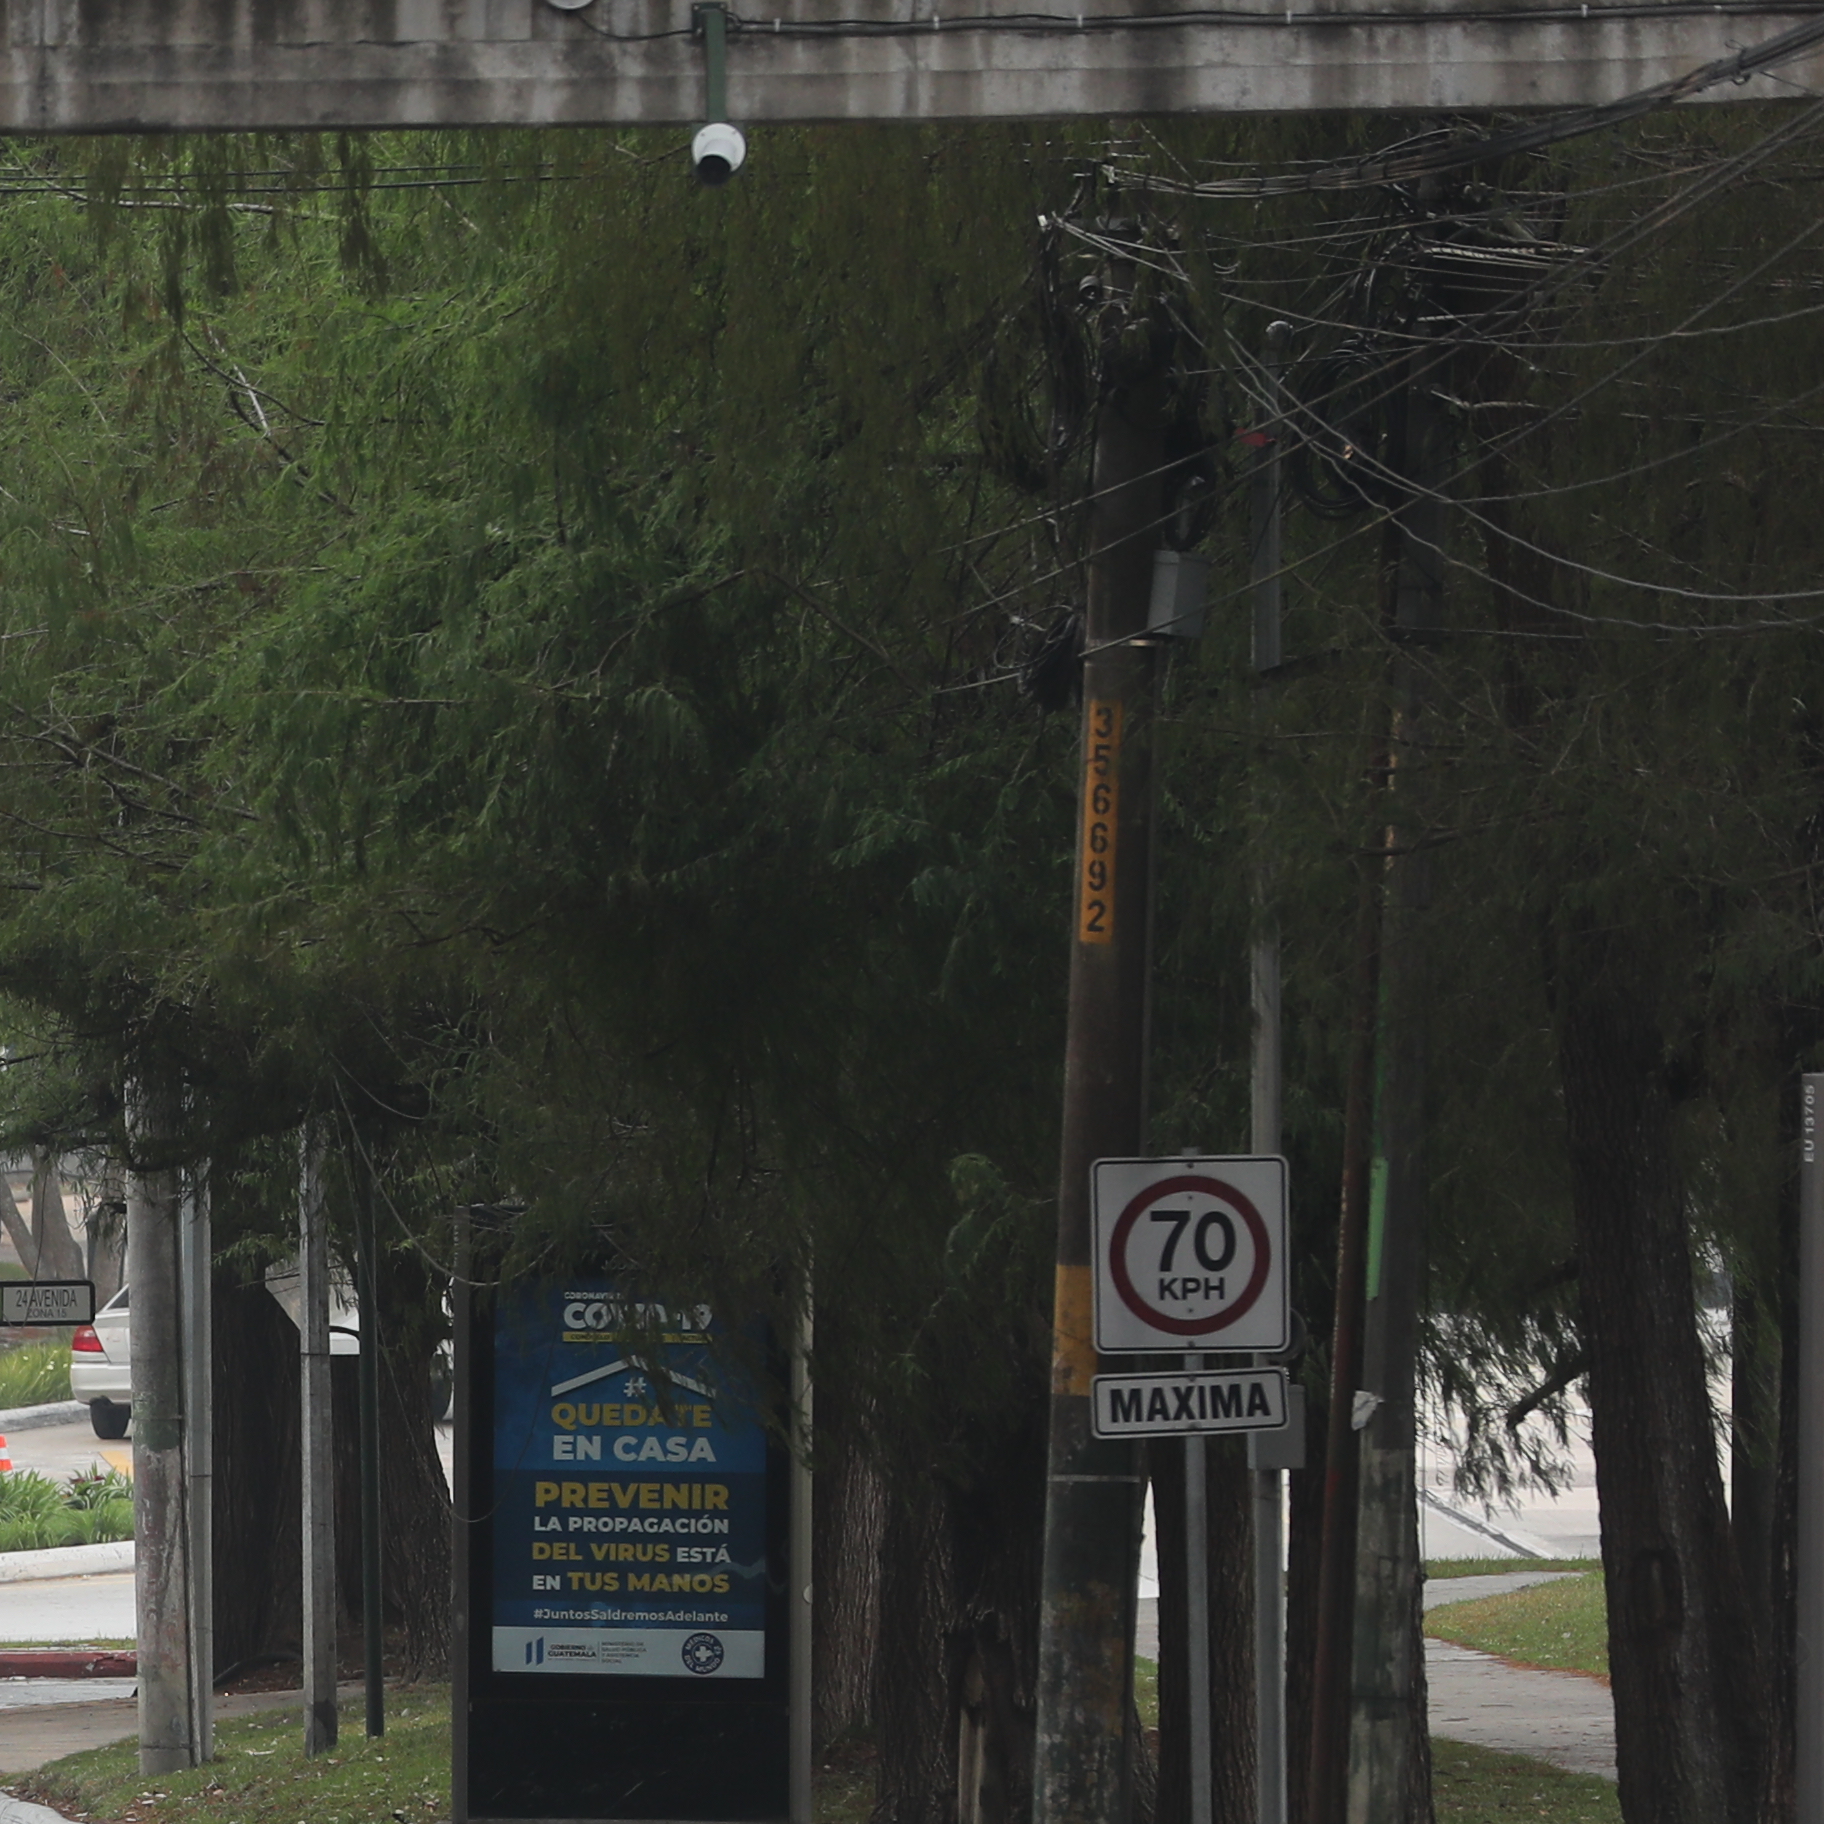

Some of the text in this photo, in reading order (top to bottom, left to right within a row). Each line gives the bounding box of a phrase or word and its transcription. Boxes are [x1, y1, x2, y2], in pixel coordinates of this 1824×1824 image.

[1087, 707, 1114, 933] 356692
[1804, 1139, 1814, 1163] EU
[1150, 1211, 1236, 1272] 70
[16, 1289, 77, 1307] 24 AVENIDA
[1159, 1277, 1225, 1300] KPH
[27, 1308, 67, 1318] ZONA 15
[1109, 1383, 1272, 1423] MAXIMA
[553, 1435, 716, 1463] EN CASA
[535, 1481, 729, 1510] PREVENIR
[534, 1514, 729, 1534] LA PROPAGACIÓN
[532, 1542, 731, 1564] DEL VIRUS ESTÁ
[532, 1571, 730, 1593] EN TUS MANOS
[533, 1609, 729, 1623] #JuntosSaldremosAdelante
